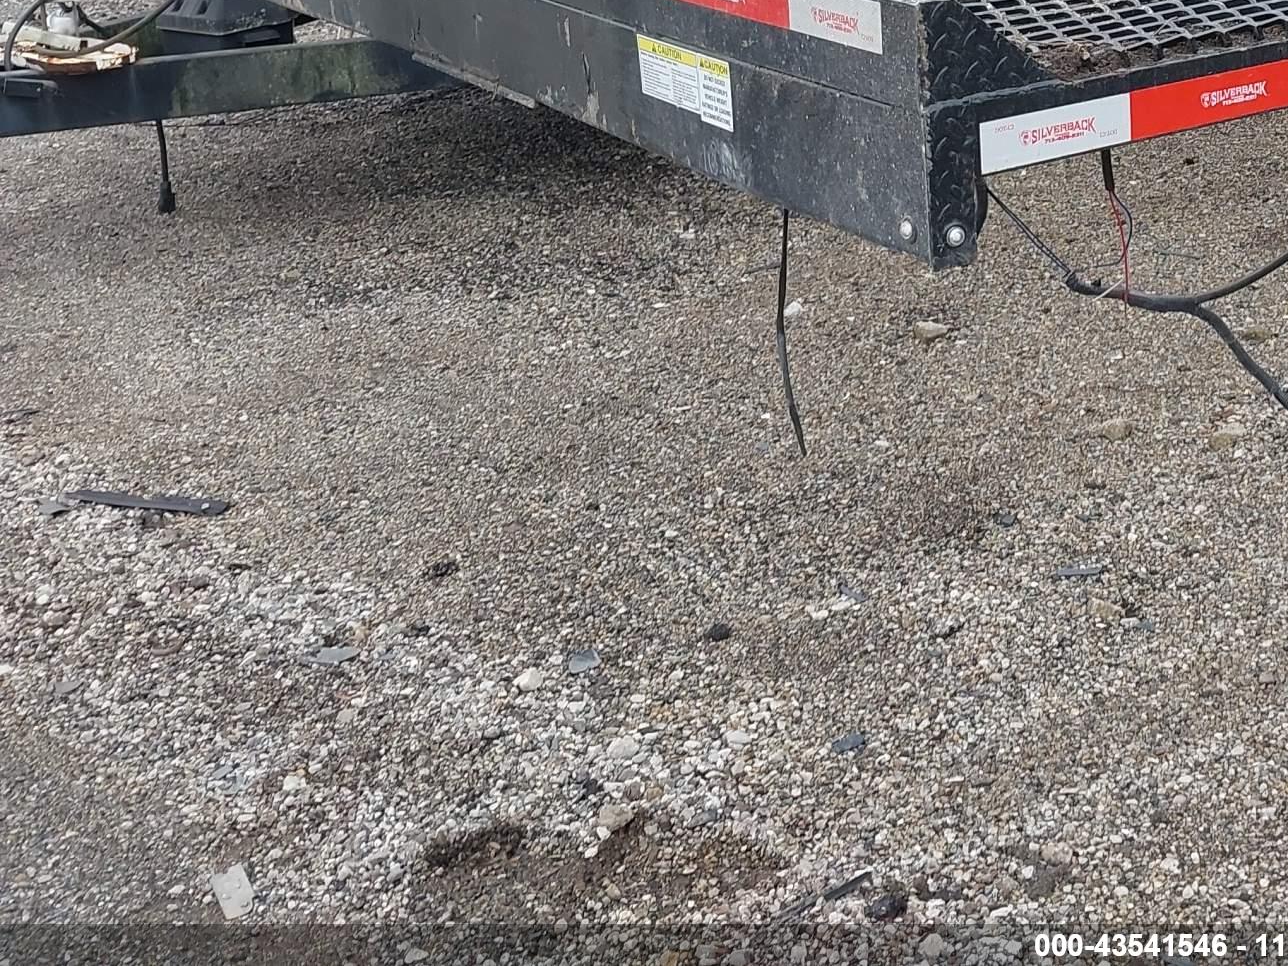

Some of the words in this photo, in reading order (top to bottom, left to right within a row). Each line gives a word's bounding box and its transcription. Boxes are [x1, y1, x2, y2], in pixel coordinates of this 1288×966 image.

[657, 44, 682, 61] CAUTION
[704, 60, 728, 75] CAUTION
[1210, 80, 1267, 107] SILVERBACK
[1031, 117, 1097, 144] SILVERBACK
